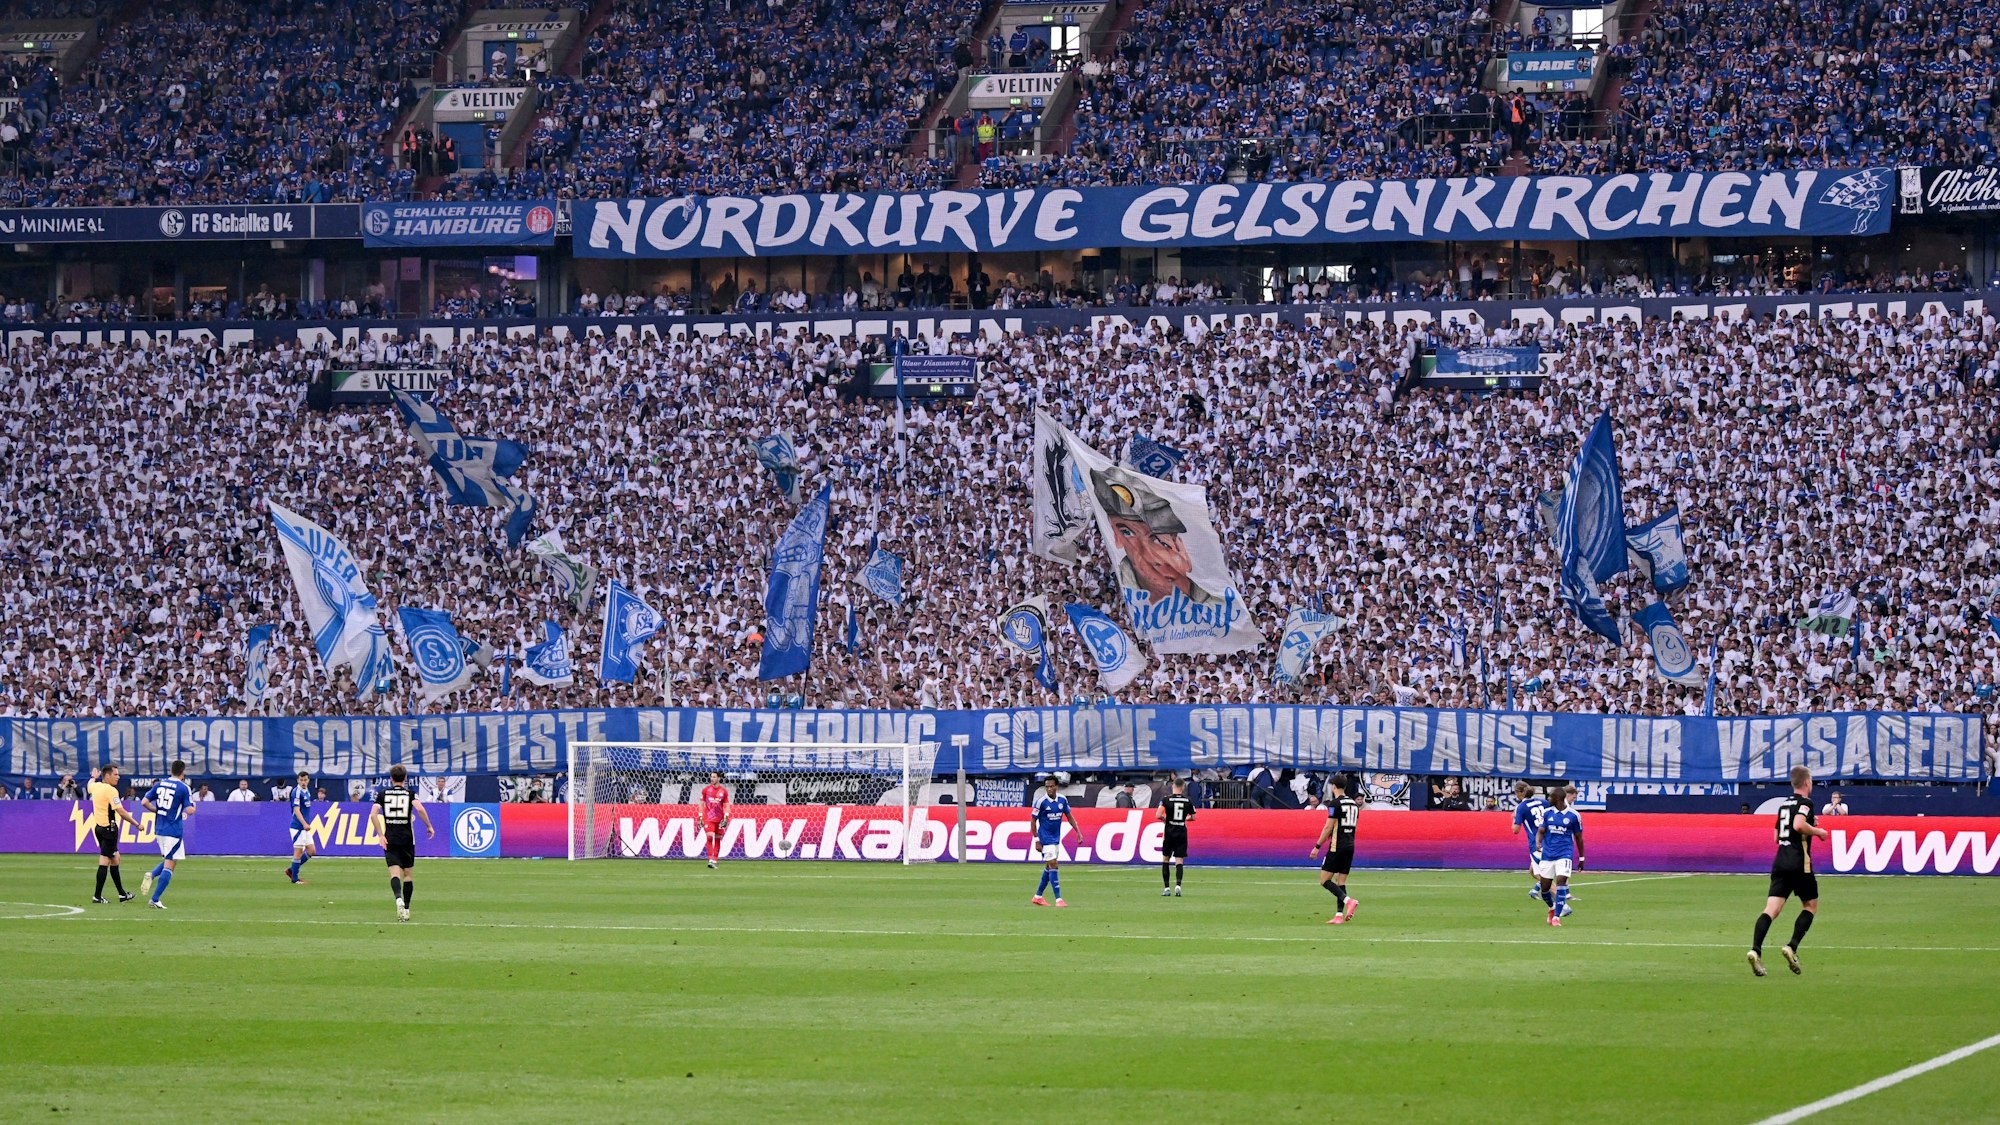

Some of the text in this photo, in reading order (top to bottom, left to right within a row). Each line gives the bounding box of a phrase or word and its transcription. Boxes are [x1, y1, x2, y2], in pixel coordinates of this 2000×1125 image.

[1526, 60, 1575, 71] RADE
[1033, 97, 1042, 105] 32
[1974, 165, 1989, 177] Ein
[394, 206, 523, 217] SCHALKER FILIALE
[588, 170, 1818, 257] NORDKURVE GELSENKIRCHEN
[21, 216, 105, 233] MINIMEAL
[191, 212, 294, 233] FC Schalke 04
[394, 218, 521, 235] HAMBURG
[954, 386, 964, 395] N3
[1510, 379, 1521, 387] N4
[10, 719, 264, 776] HISTORISCH
[293, 711, 608, 775] SCHLECHTESTE
[637, 711, 936, 769] PLATZIERUNG
[983, 705, 1158, 768] SCHÖNE
[1190, 708, 1567, 777] SOMMERPAUSE,
[1602, 718, 1681, 779] IHR
[1717, 715, 1981, 779] VERSAGER!
[976, 780, 1024, 791] FUSSBALLCLUB
[156, 787, 175, 809] 35
[976, 790, 1024, 802] GELSENKIRCHEN
[384, 795, 410, 817] 29
[1174, 802, 1185, 820] 6
[1341, 805, 1358, 827] 30
